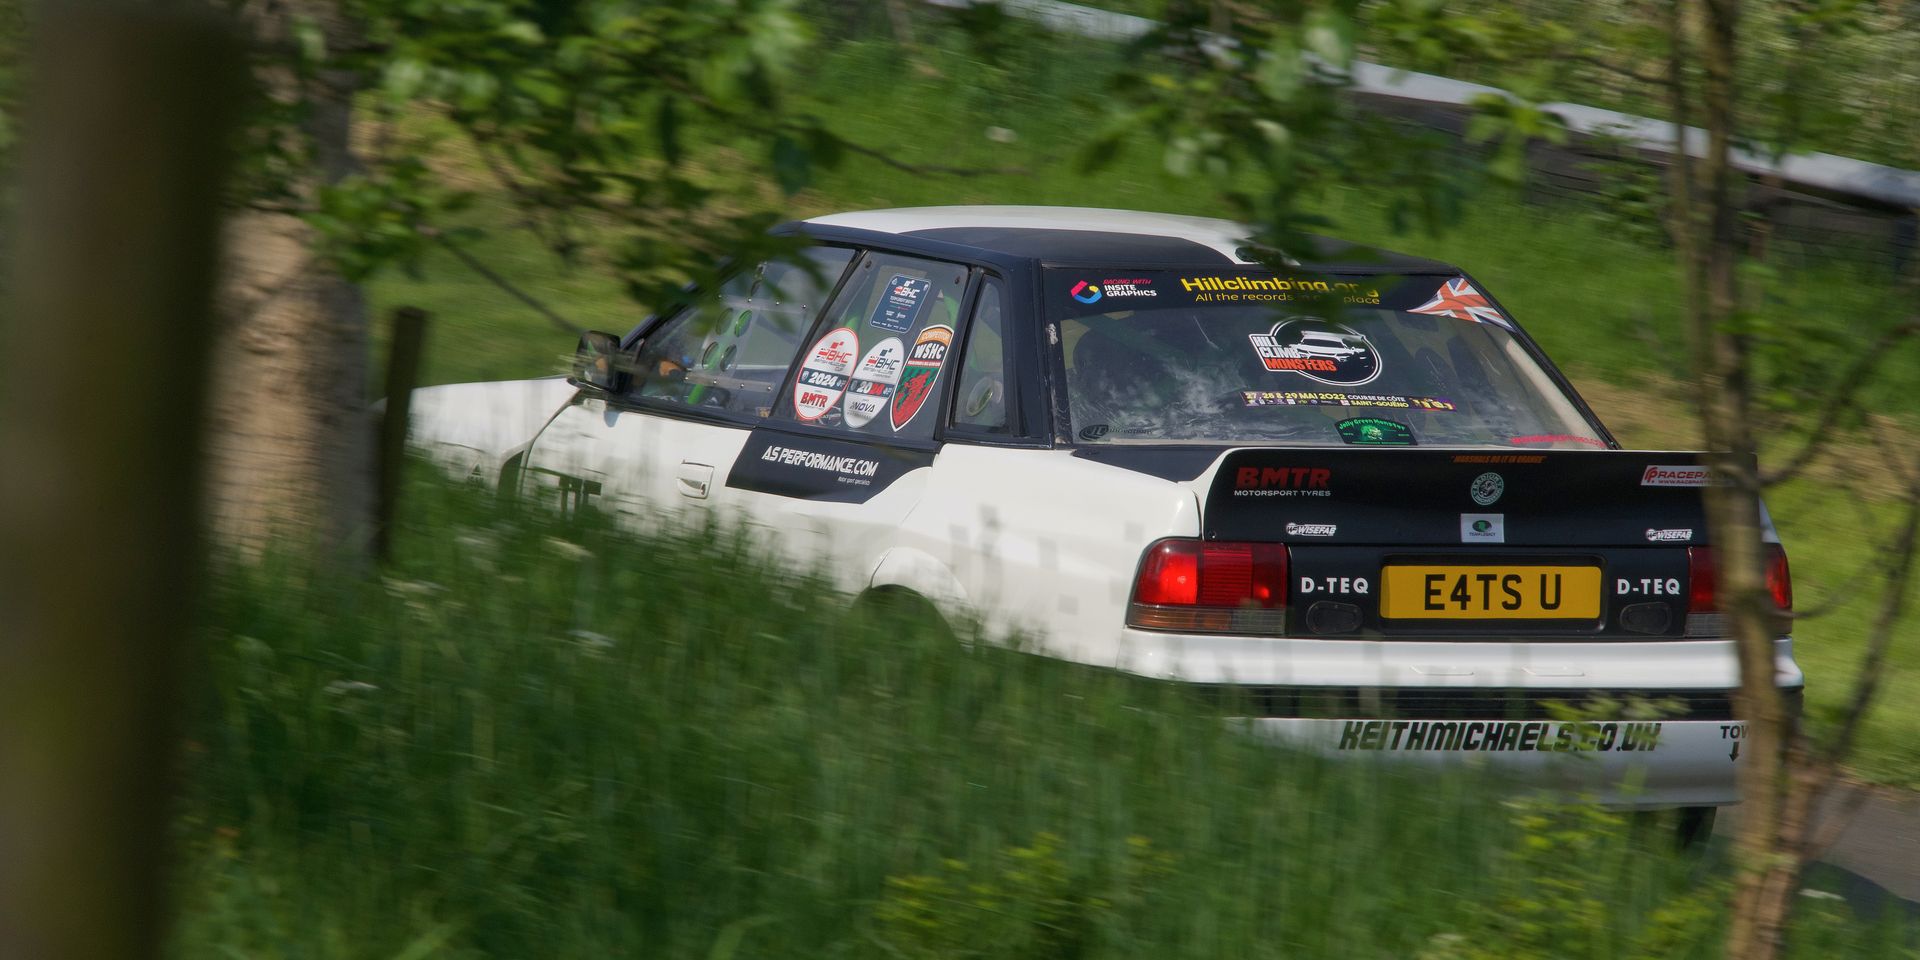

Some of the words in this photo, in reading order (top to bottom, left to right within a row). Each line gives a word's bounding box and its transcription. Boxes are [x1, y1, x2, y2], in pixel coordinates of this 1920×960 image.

[899, 287, 920, 299] BHC
[1195, 293, 1213, 302] All
[1216, 293, 1239, 301] the
[1242, 292, 1294, 302] records
[1252, 336, 1282, 346] HILL
[826, 350, 852, 363] BHC
[914, 342, 945, 360] WSHC
[1259, 346, 1300, 358] CLIMB
[875, 357, 900, 371] BHC
[1264, 357, 1338, 372] MONSTERS
[808, 372, 838, 388] 2024
[800, 392, 828, 408] BMTR
[761, 445, 782, 461] AS
[778, 448, 879, 477] PERFORMANCE.COM
[1236, 467, 1330, 488] BMTR
[1298, 525, 1336, 536] WISEFAB
[1657, 530, 1693, 541] WISEFAB
[1301, 577, 1369, 594] D-TEQ
[1424, 573, 1522, 610] E4TS
[1540, 573, 1562, 610] U
[1617, 578, 1681, 595] D-TEQ
